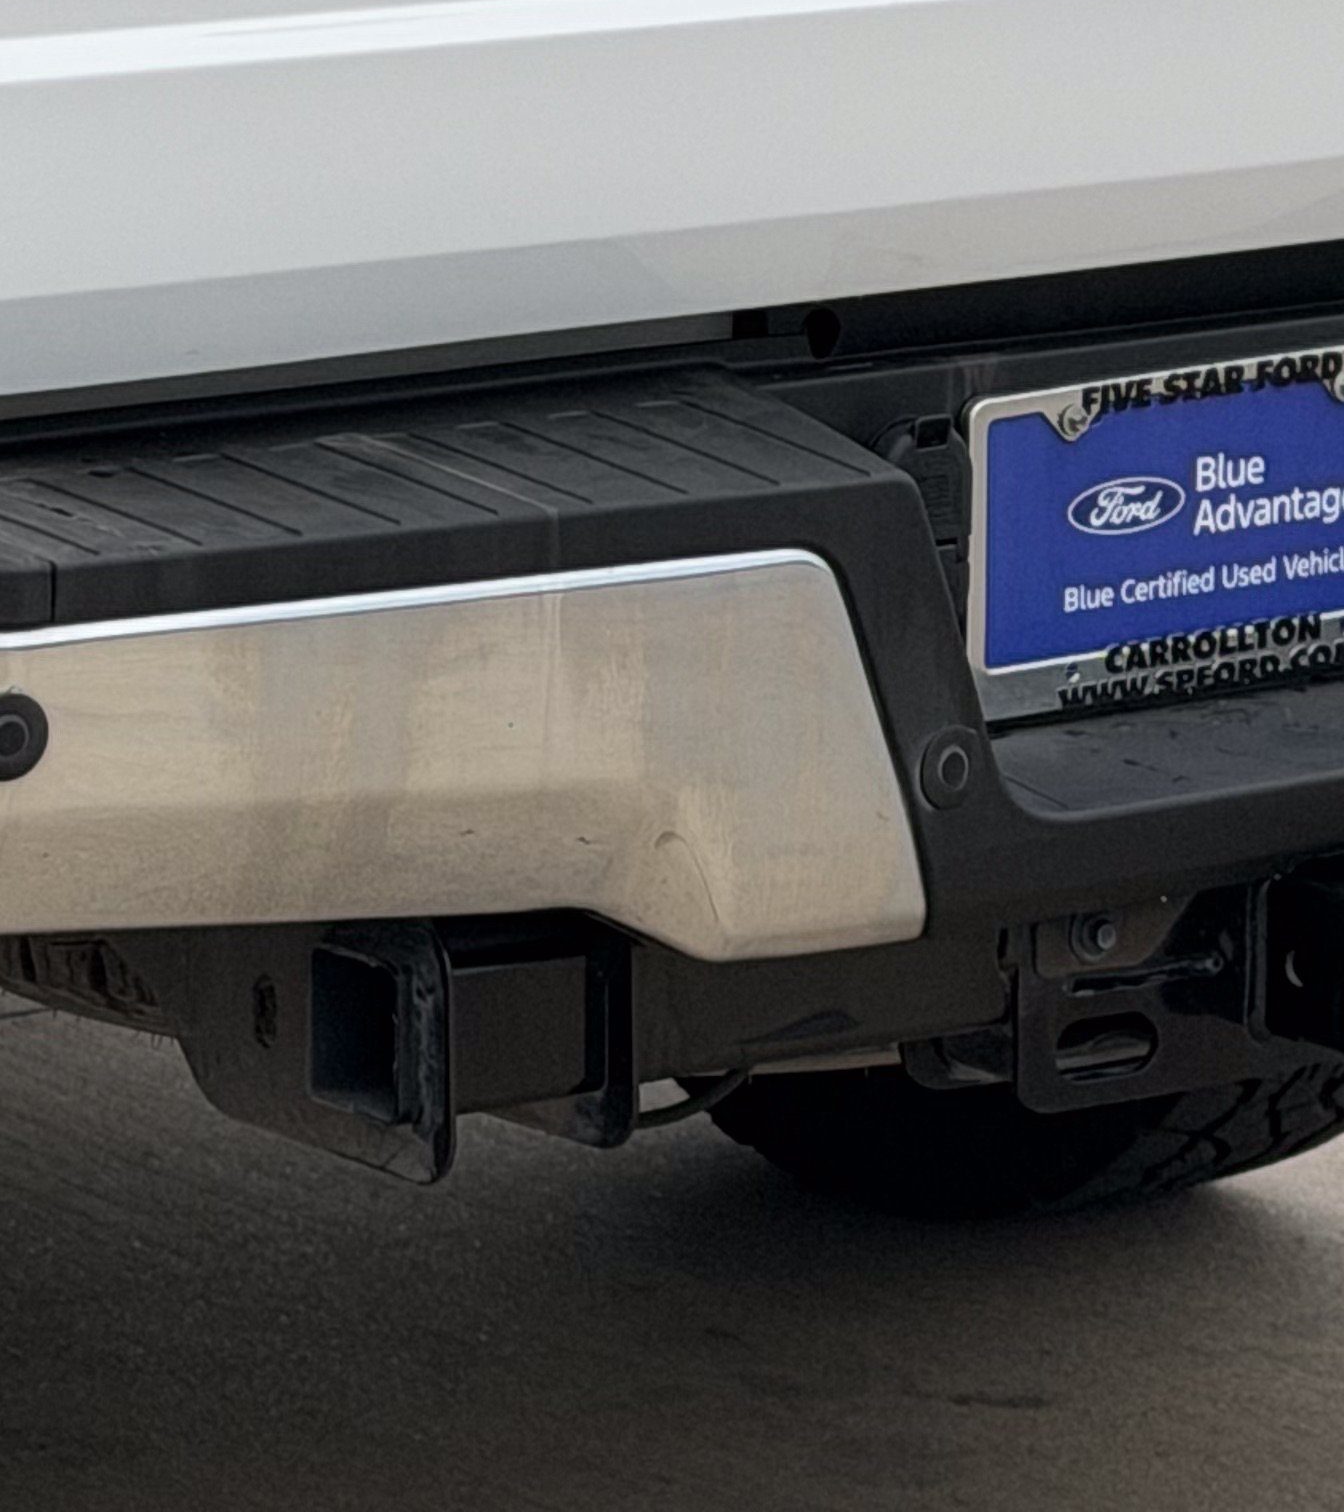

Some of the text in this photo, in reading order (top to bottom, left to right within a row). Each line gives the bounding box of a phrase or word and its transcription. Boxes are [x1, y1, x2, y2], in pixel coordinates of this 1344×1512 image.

[1082, 351, 1344, 416] FIVE STAR FORD
[1194, 451, 1266, 493] Blue
[1088, 485, 1164, 527] Ford
[1063, 584, 1116, 613] Blue
[1119, 565, 1216, 604] Certified
[1221, 555, 1277, 589] Used
[1104, 612, 1323, 675] CARROLLTON
